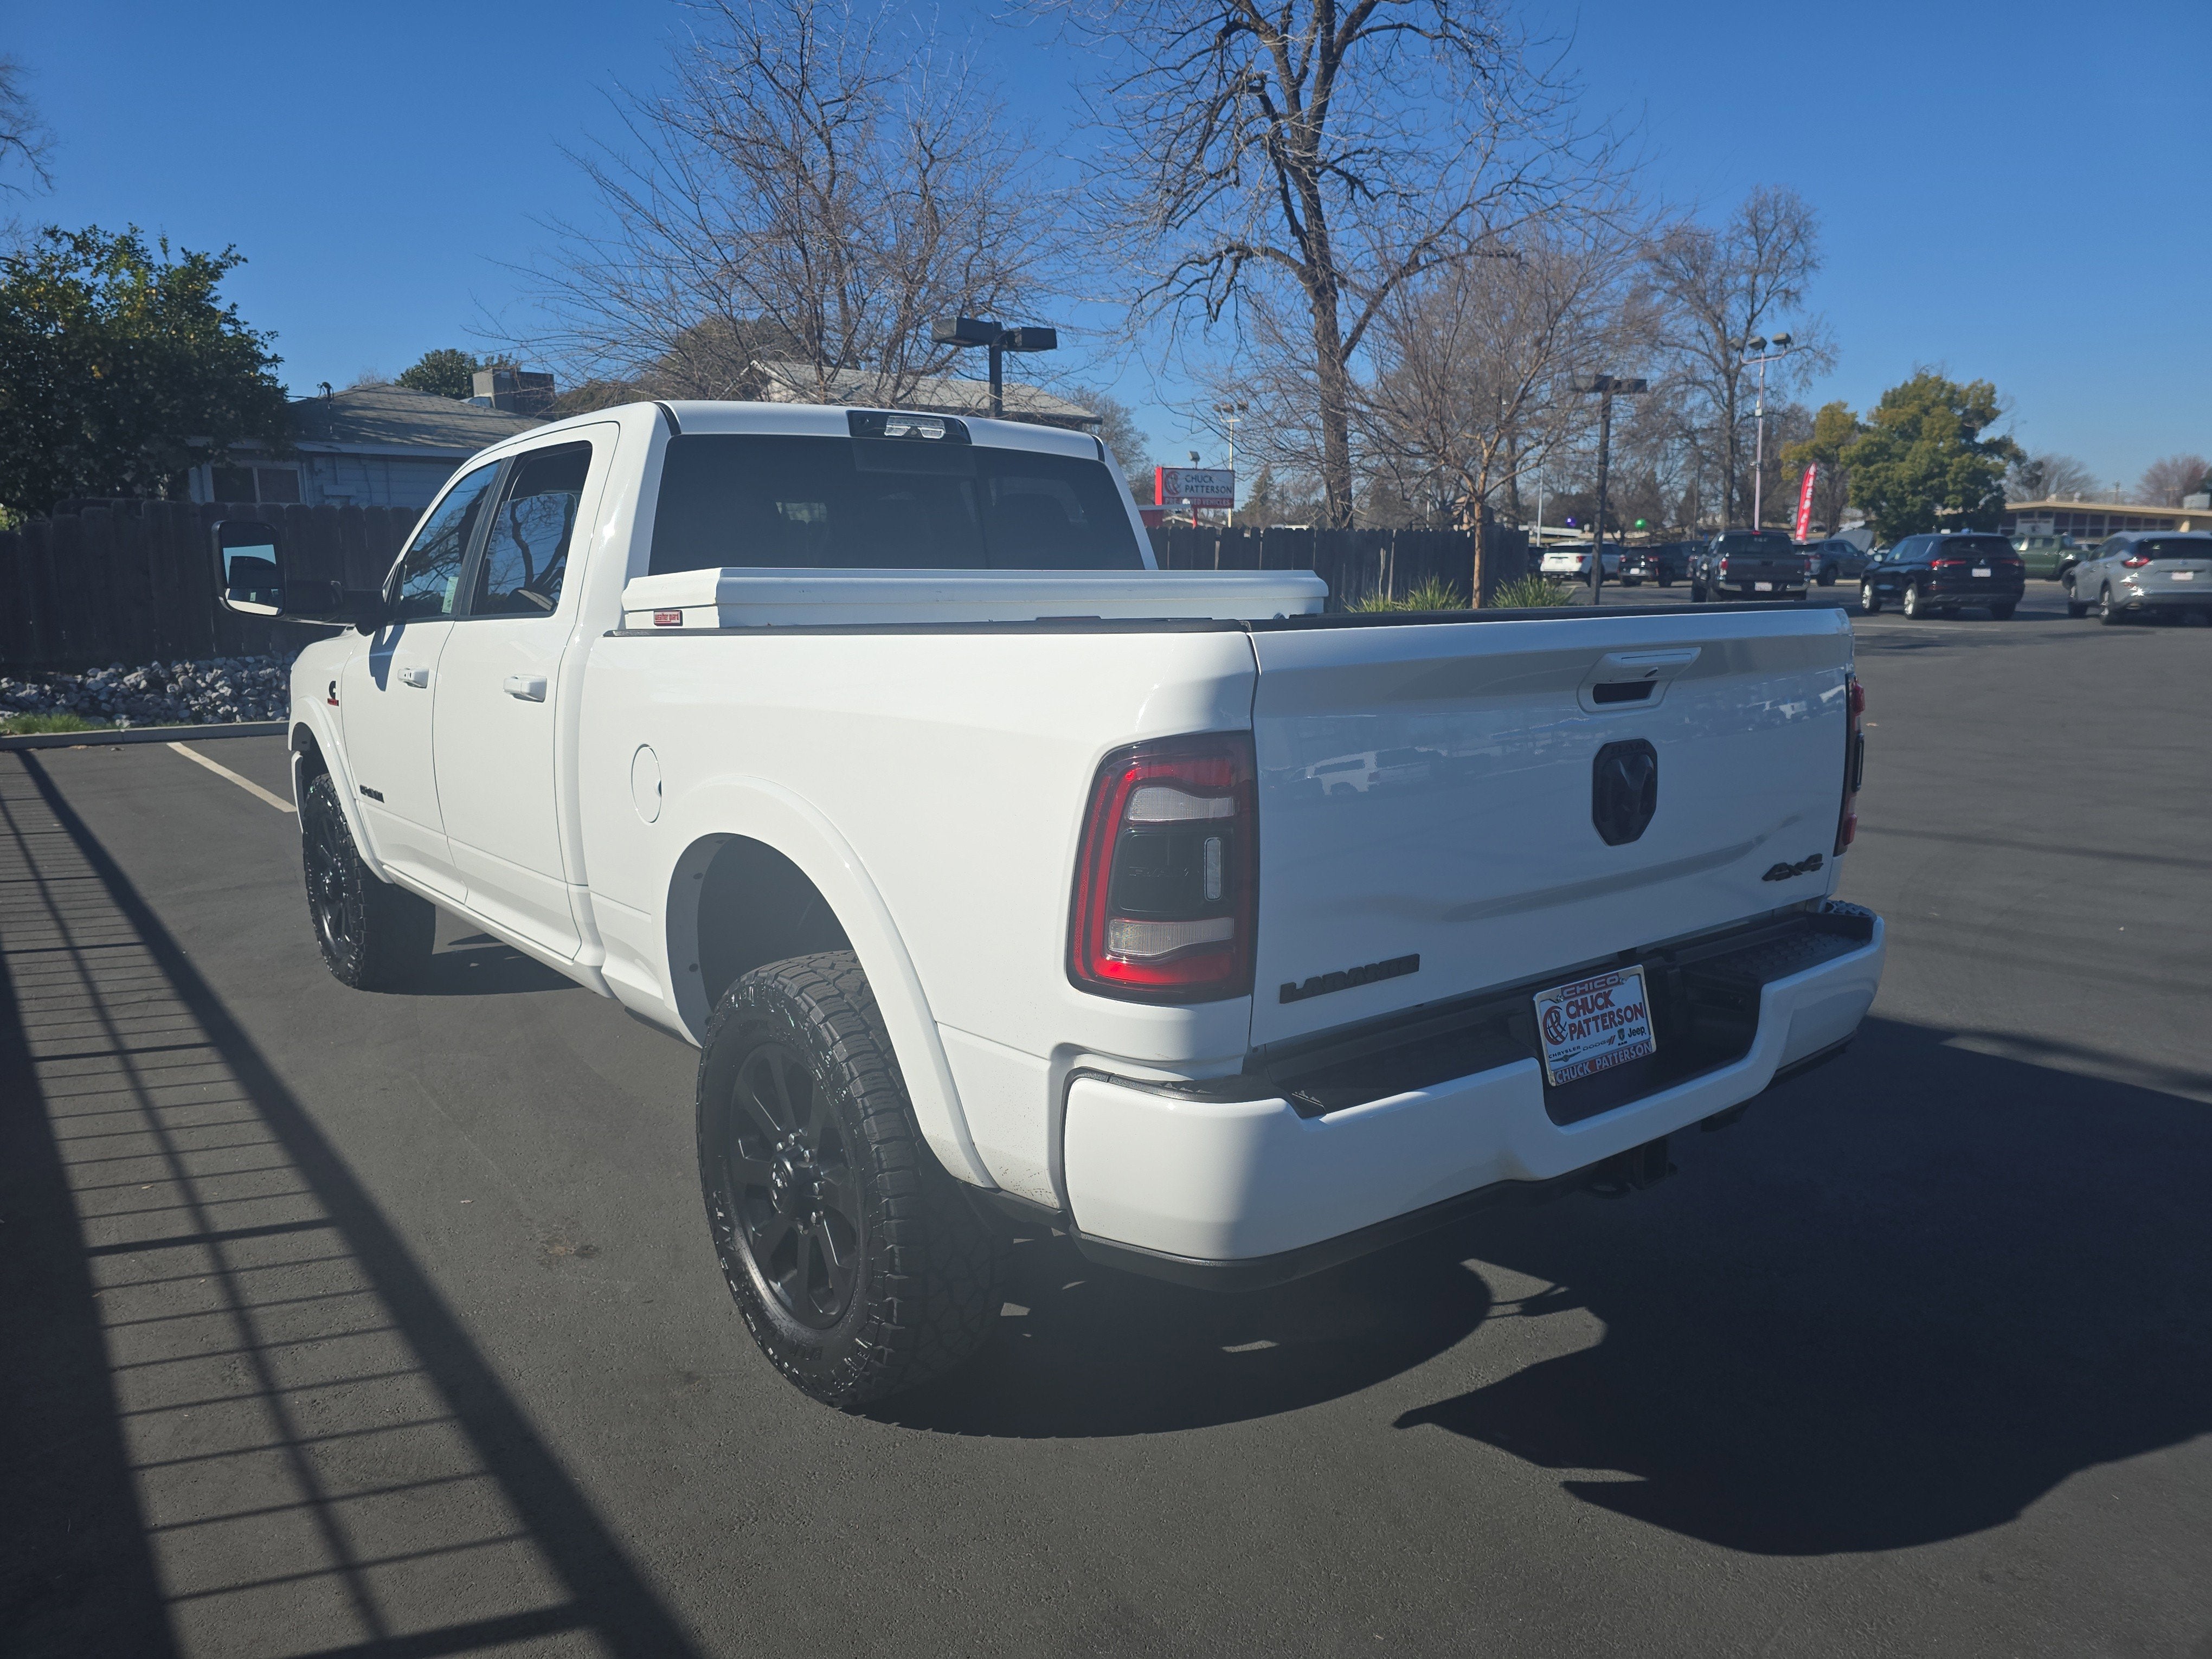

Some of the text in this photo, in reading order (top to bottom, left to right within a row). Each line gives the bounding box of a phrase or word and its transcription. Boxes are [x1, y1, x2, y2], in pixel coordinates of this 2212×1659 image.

[1185, 474, 1214, 484] CHUCK
[1185, 484, 1232, 494] PATTERSON
[1562, 975, 1619, 998] CHICO
[1566, 989, 1615, 1019] CHUCK
[1568, 1002, 1645, 1041] PATTERSON
[1549, 1045, 1581, 1059] CHRYSLER
[1628, 1026, 1646, 1038] Jeep
[1555, 1041, 1652, 1084] CHUCK PATTERSON
